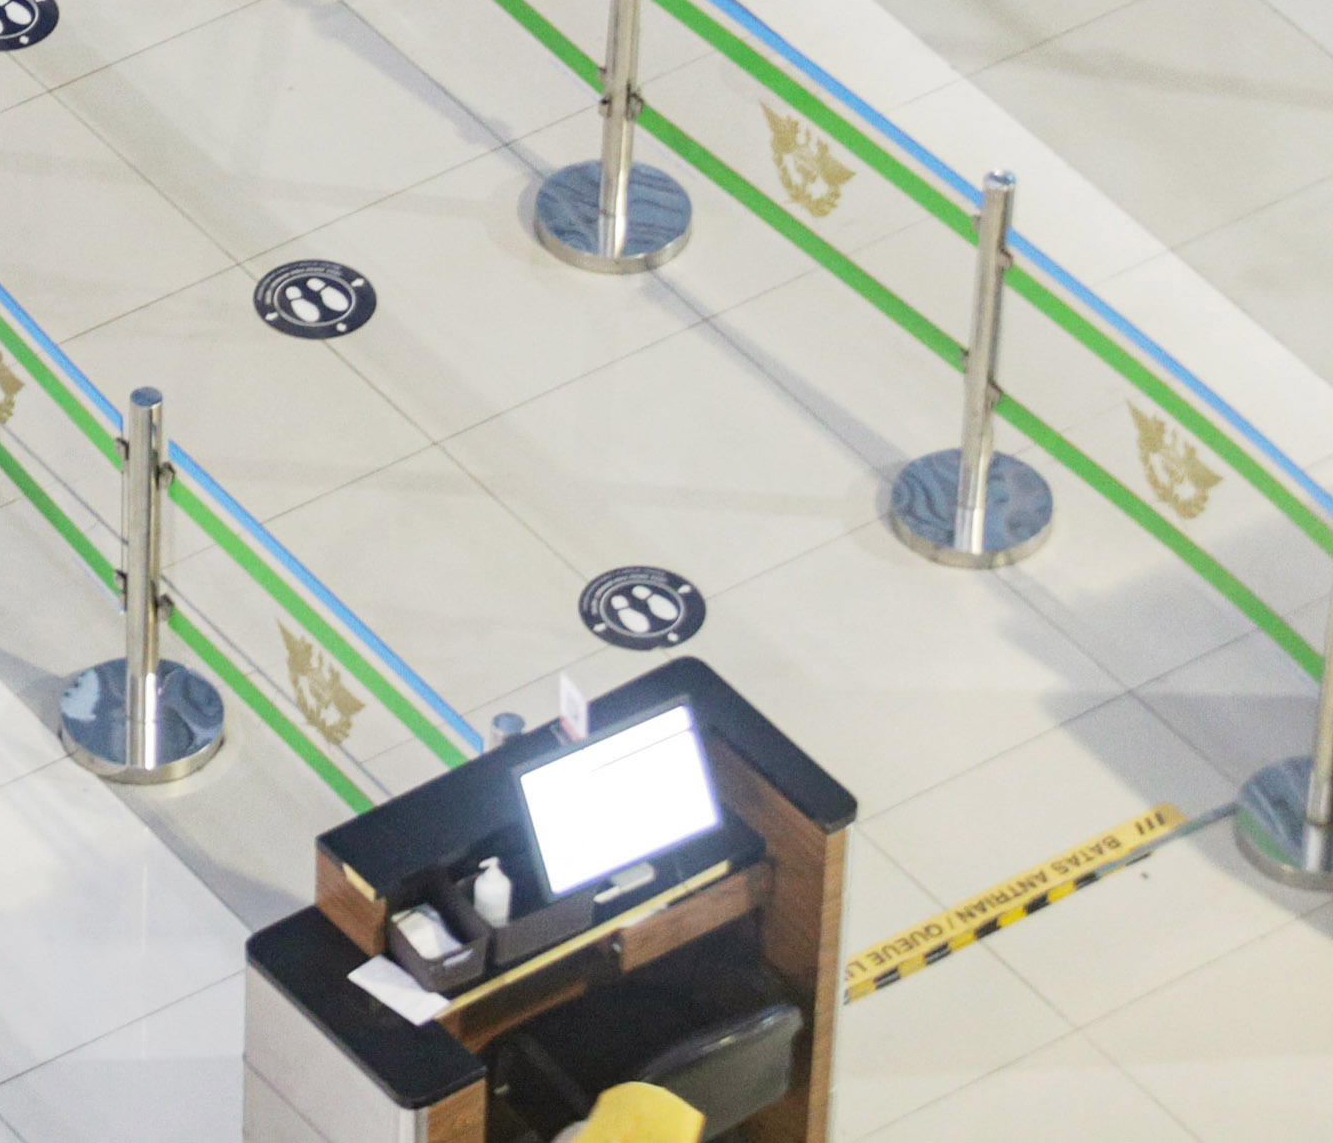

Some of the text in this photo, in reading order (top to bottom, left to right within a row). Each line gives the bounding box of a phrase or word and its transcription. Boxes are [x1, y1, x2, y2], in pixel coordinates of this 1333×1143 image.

[1050, 834, 1123, 875] BATAS
[954, 870, 1049, 924] ANTRIAN
[866, 923, 944, 967] QUEUE
